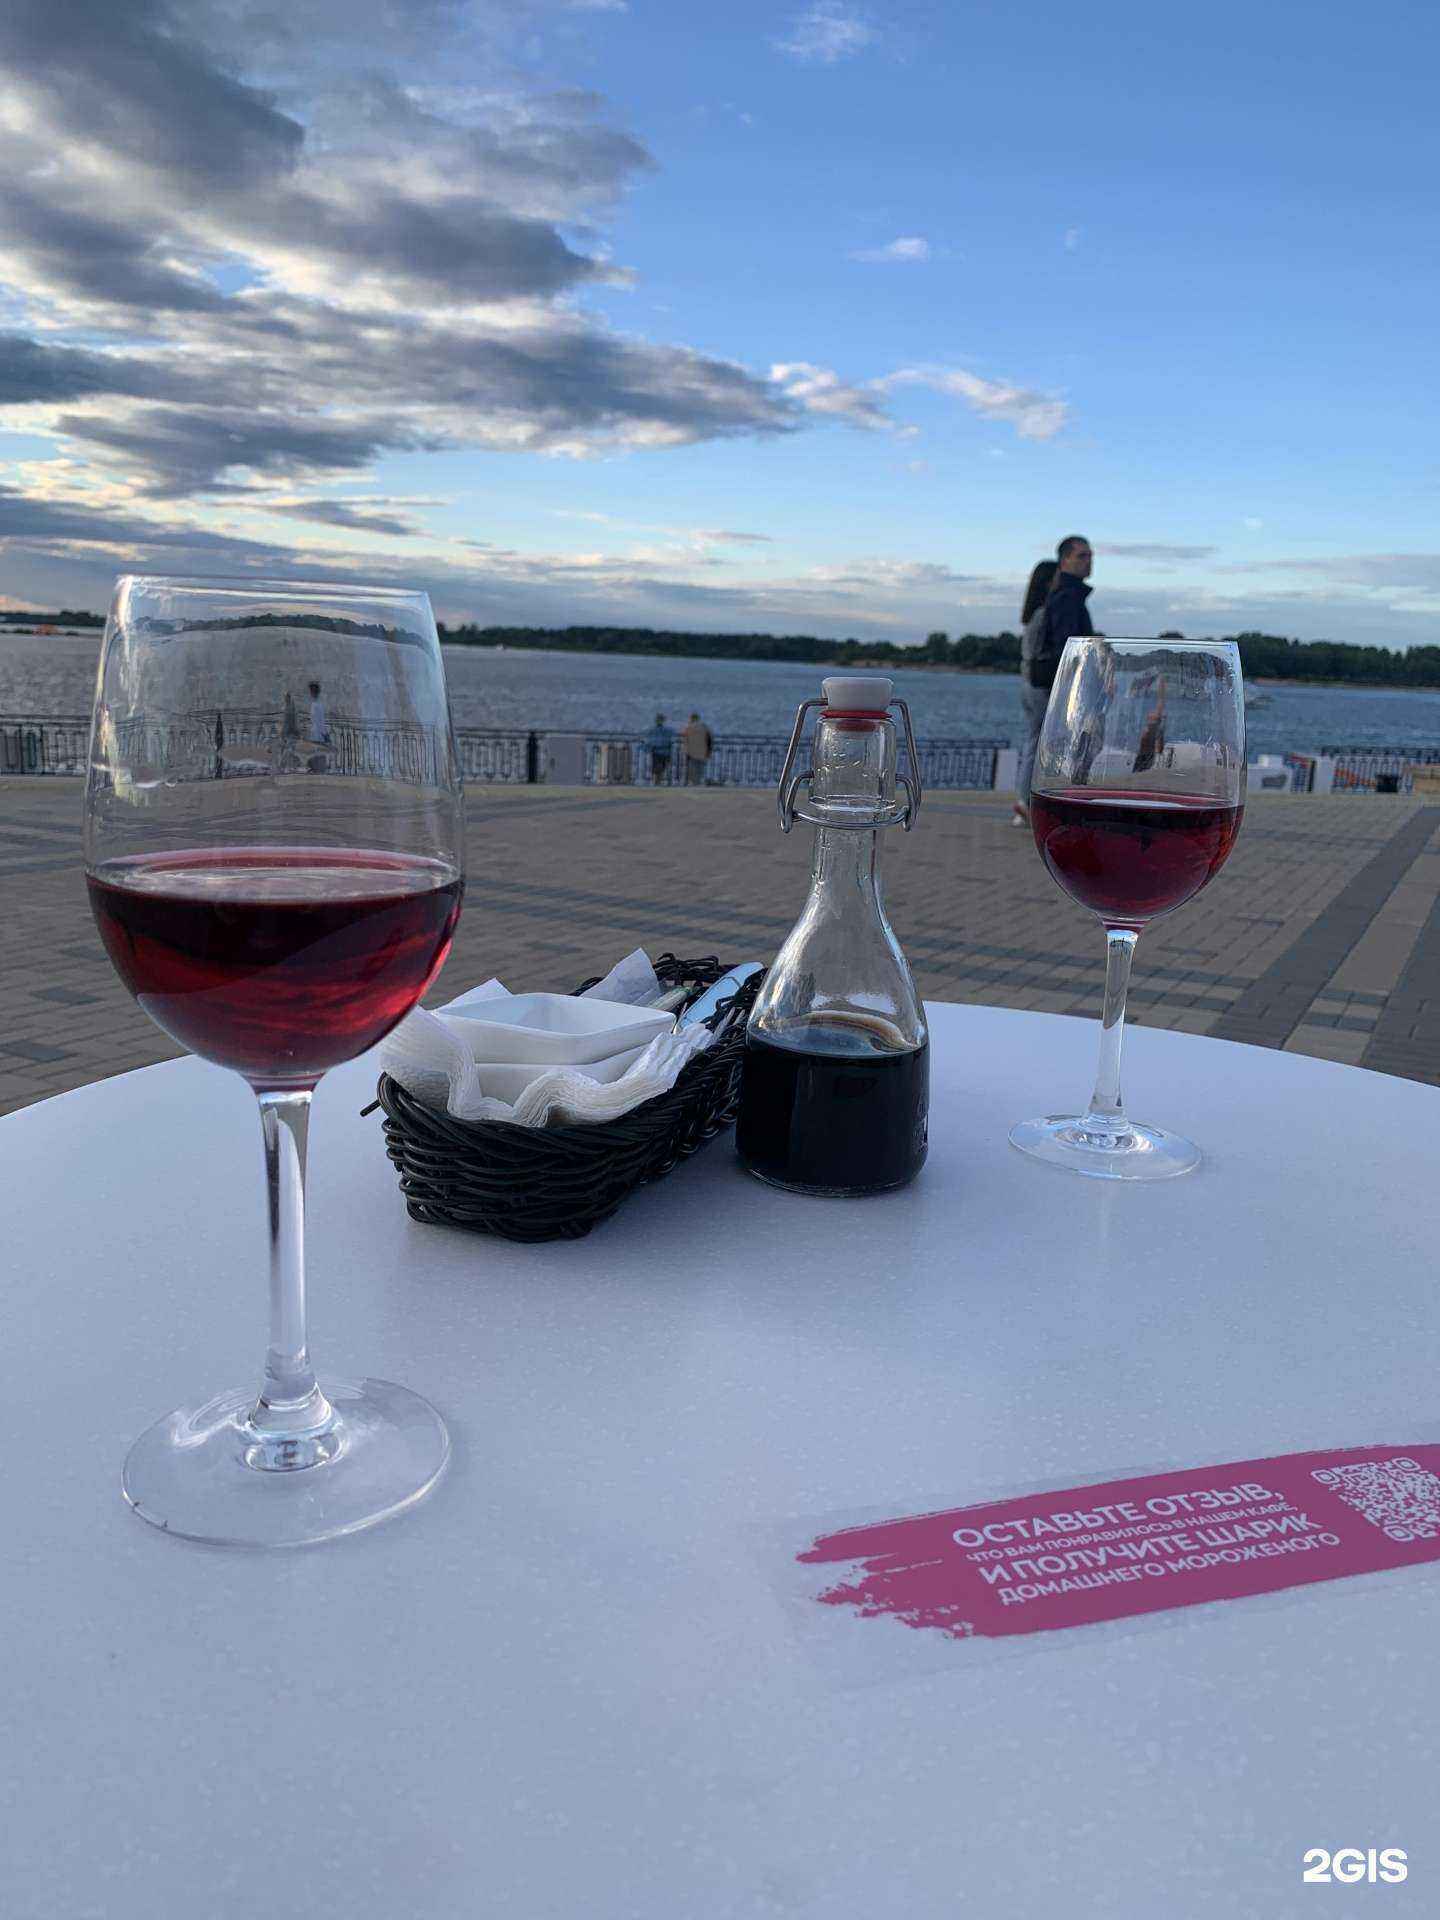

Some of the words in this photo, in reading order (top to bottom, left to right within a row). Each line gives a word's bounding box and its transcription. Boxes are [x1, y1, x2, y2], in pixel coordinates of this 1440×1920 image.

[953, 1502, 1147, 1547] ОСТАВЬТЕ
[1145, 1483, 1285, 1516] ОТЗЫВ,
[966, 1550, 1004, 1563] ЧТО
[1005, 1542, 1045, 1558] ВАМ
[1044, 1519, 1173, 1550] ПОНРАВИЛОСЬ
[1173, 1519, 1187, 1529] В
[1186, 1508, 1248, 1527] НАШЕМ
[979, 1564, 1012, 1584] И
[1011, 1533, 1200, 1580] ПОЛУЧИТЕ
[1195, 1512, 1324, 1547] ШАРИК
[997, 1562, 1166, 1606] ДОМАШНЕГО
[1165, 1532, 1341, 1574] МОРОЖЕНОГО
